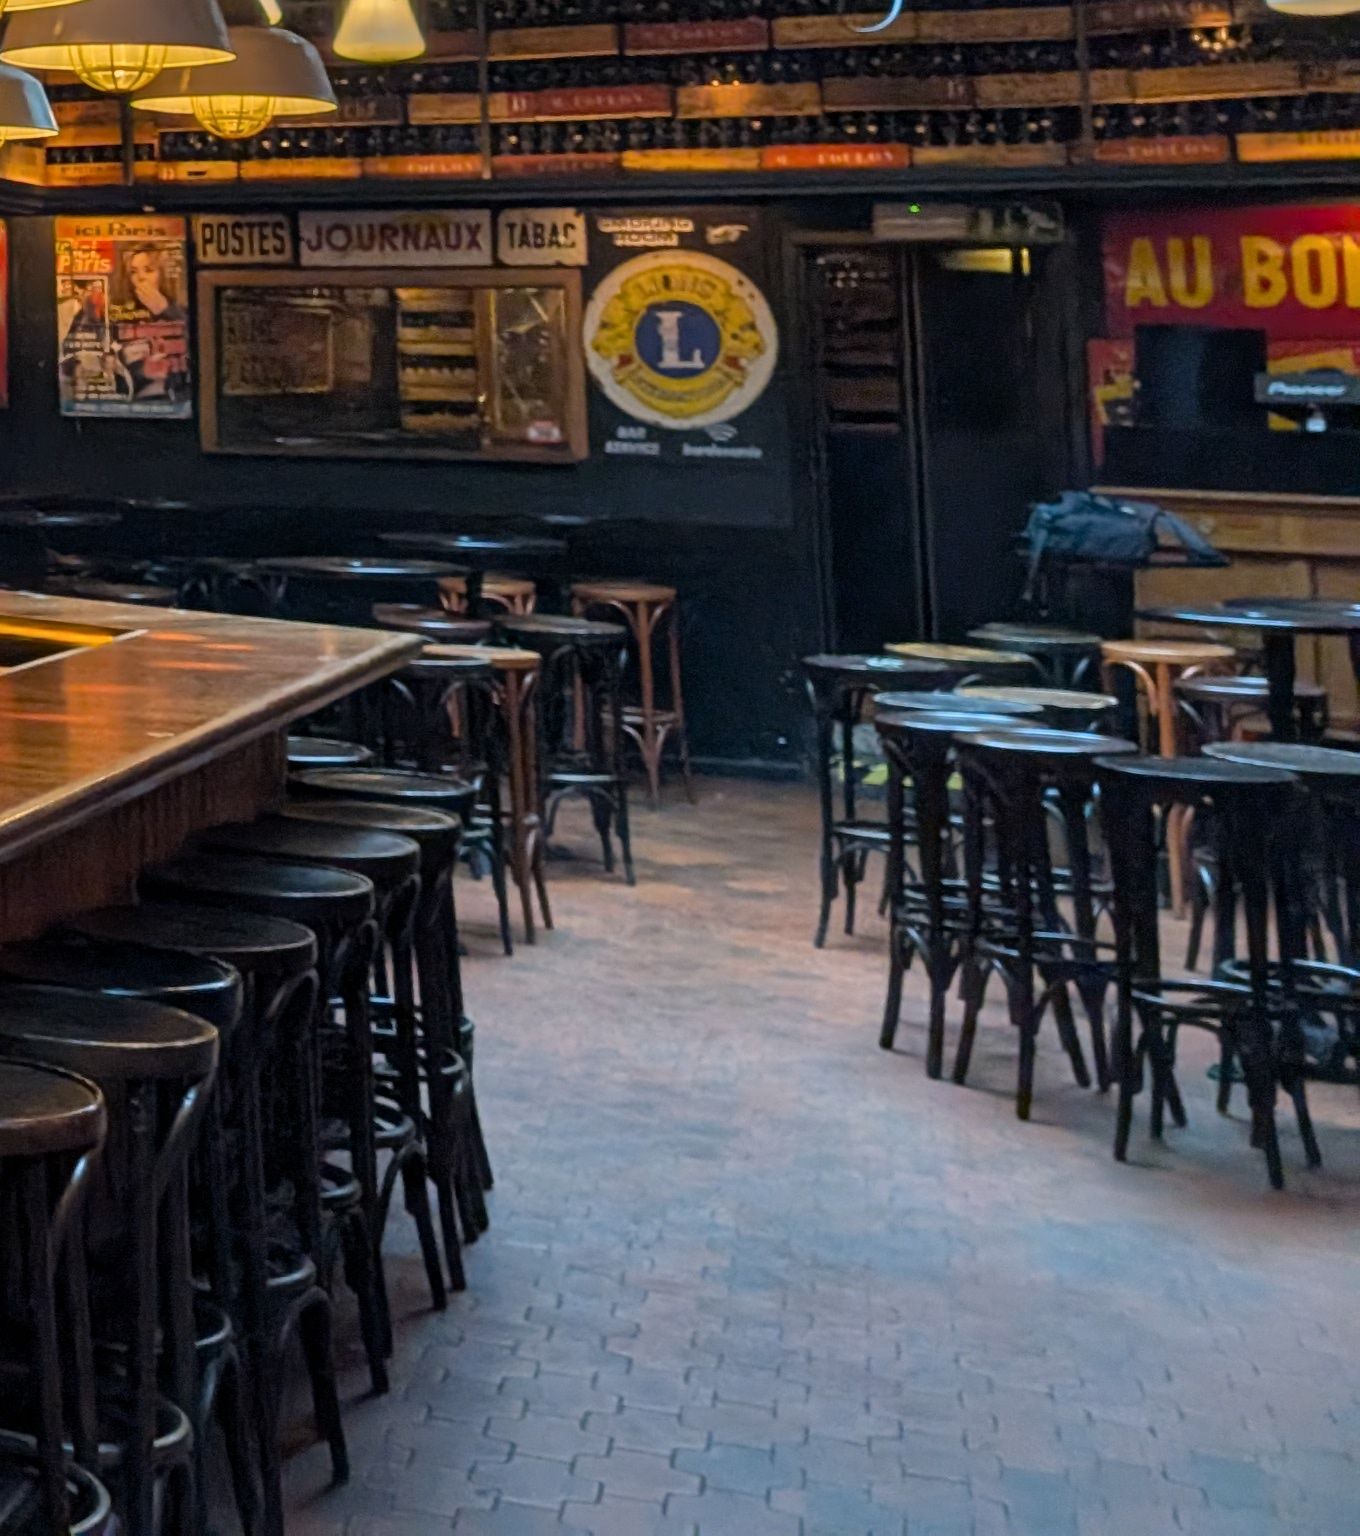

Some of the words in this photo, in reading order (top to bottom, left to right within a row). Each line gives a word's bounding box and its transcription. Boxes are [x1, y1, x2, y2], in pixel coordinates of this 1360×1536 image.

[108, 221, 167, 237] Paris
[201, 221, 286, 257] POSTES
[306, 222, 482, 254] JOURNAUX
[505, 220, 577, 250] TABAC
[1125, 236, 1214, 309] AU
[655, 310, 707, 369] L
